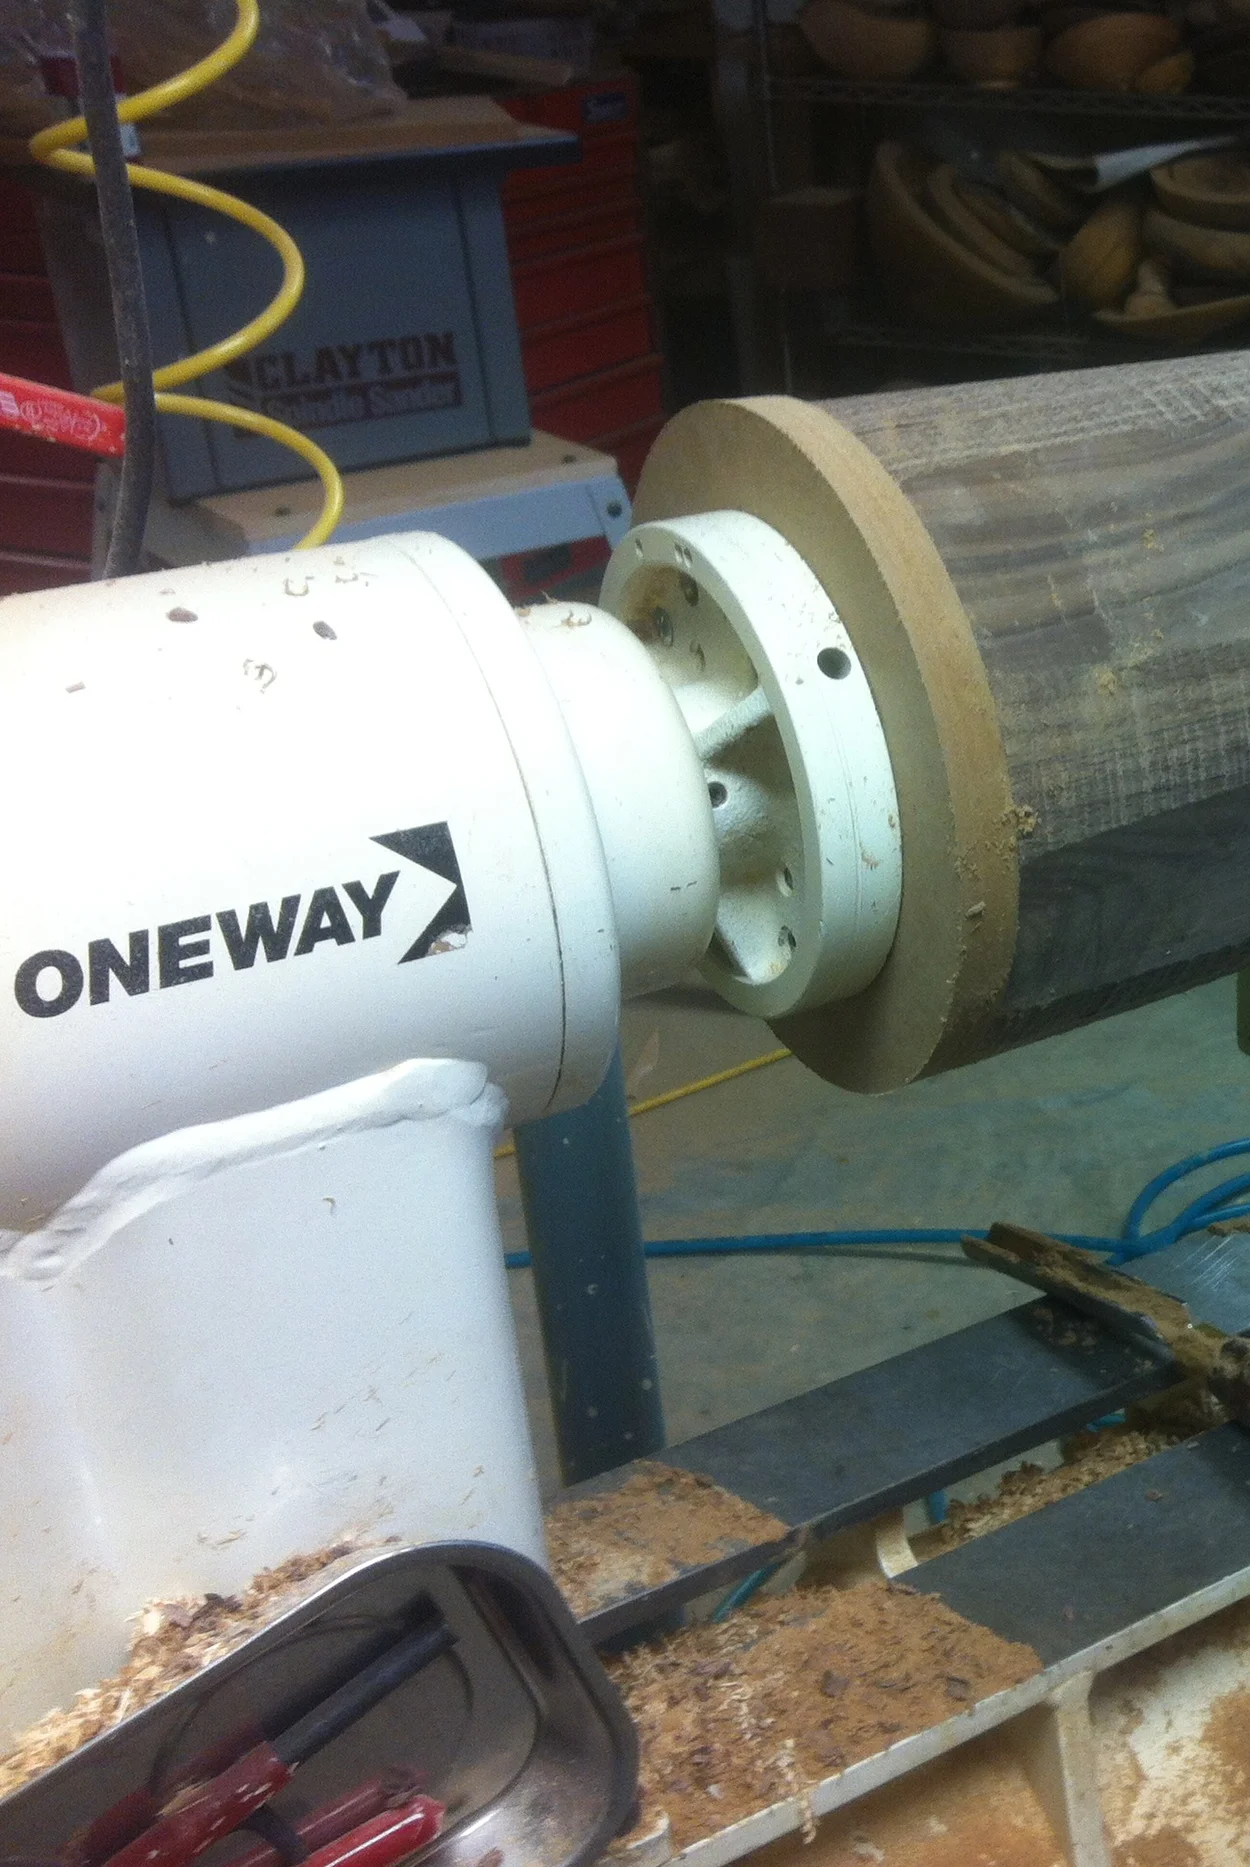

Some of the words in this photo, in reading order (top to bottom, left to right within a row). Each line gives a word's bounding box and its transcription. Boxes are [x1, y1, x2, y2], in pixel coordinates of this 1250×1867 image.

[255, 332, 458, 390] CLAYTON
[368, 381, 455, 418] Sander
[14, 870, 401, 1018] ONEWAY
